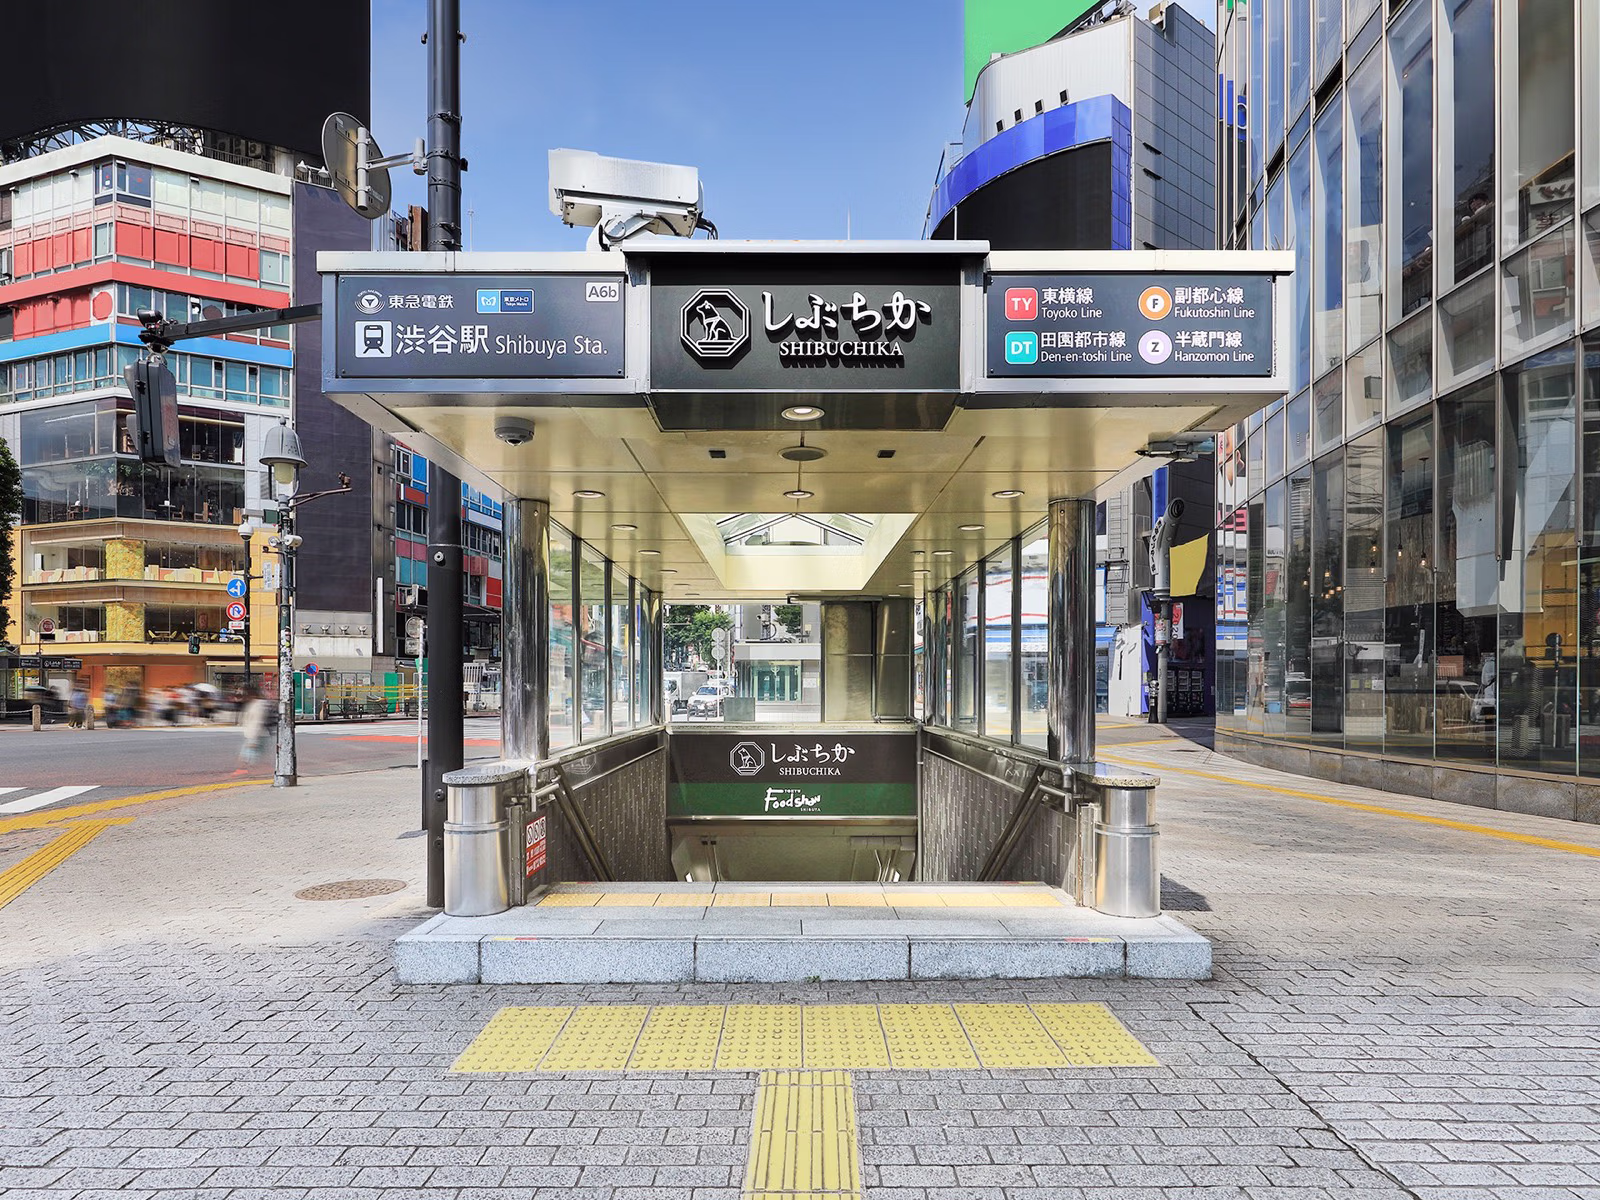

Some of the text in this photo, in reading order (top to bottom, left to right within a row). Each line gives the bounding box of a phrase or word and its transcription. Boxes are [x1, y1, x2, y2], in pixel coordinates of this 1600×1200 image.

[588, 285, 617, 298] A6b
[1041, 287, 1094, 305] 東横線
[1174, 287, 1244, 305] 副都心線
[388, 294, 454, 309] 東急電鉄
[1011, 298, 1033, 310] TY
[1152, 299, 1159, 309] F
[762, 291, 931, 331] しぶちか
[1041, 306, 1103, 320] Toyoko Line
[1174, 306, 1255, 318] Fukutoshin Line
[395, 324, 608, 360] 渋谷駅 Shibuya Sta.
[1041, 331, 1127, 348] 田園都市線
[1174, 331, 1243, 348] 半蔵門線
[779, 341, 904, 356] SHIBUCHIKA
[1011, 341, 1033, 355] DT
[1151, 341, 1160, 353] Z
[1041, 350, 1132, 362] Den-en-toshi Line
[1174, 350, 1255, 362] Hanzomon Line
[770, 743, 856, 763] しぶちか
[779, 767, 841, 776] SHIBUCHIKA
